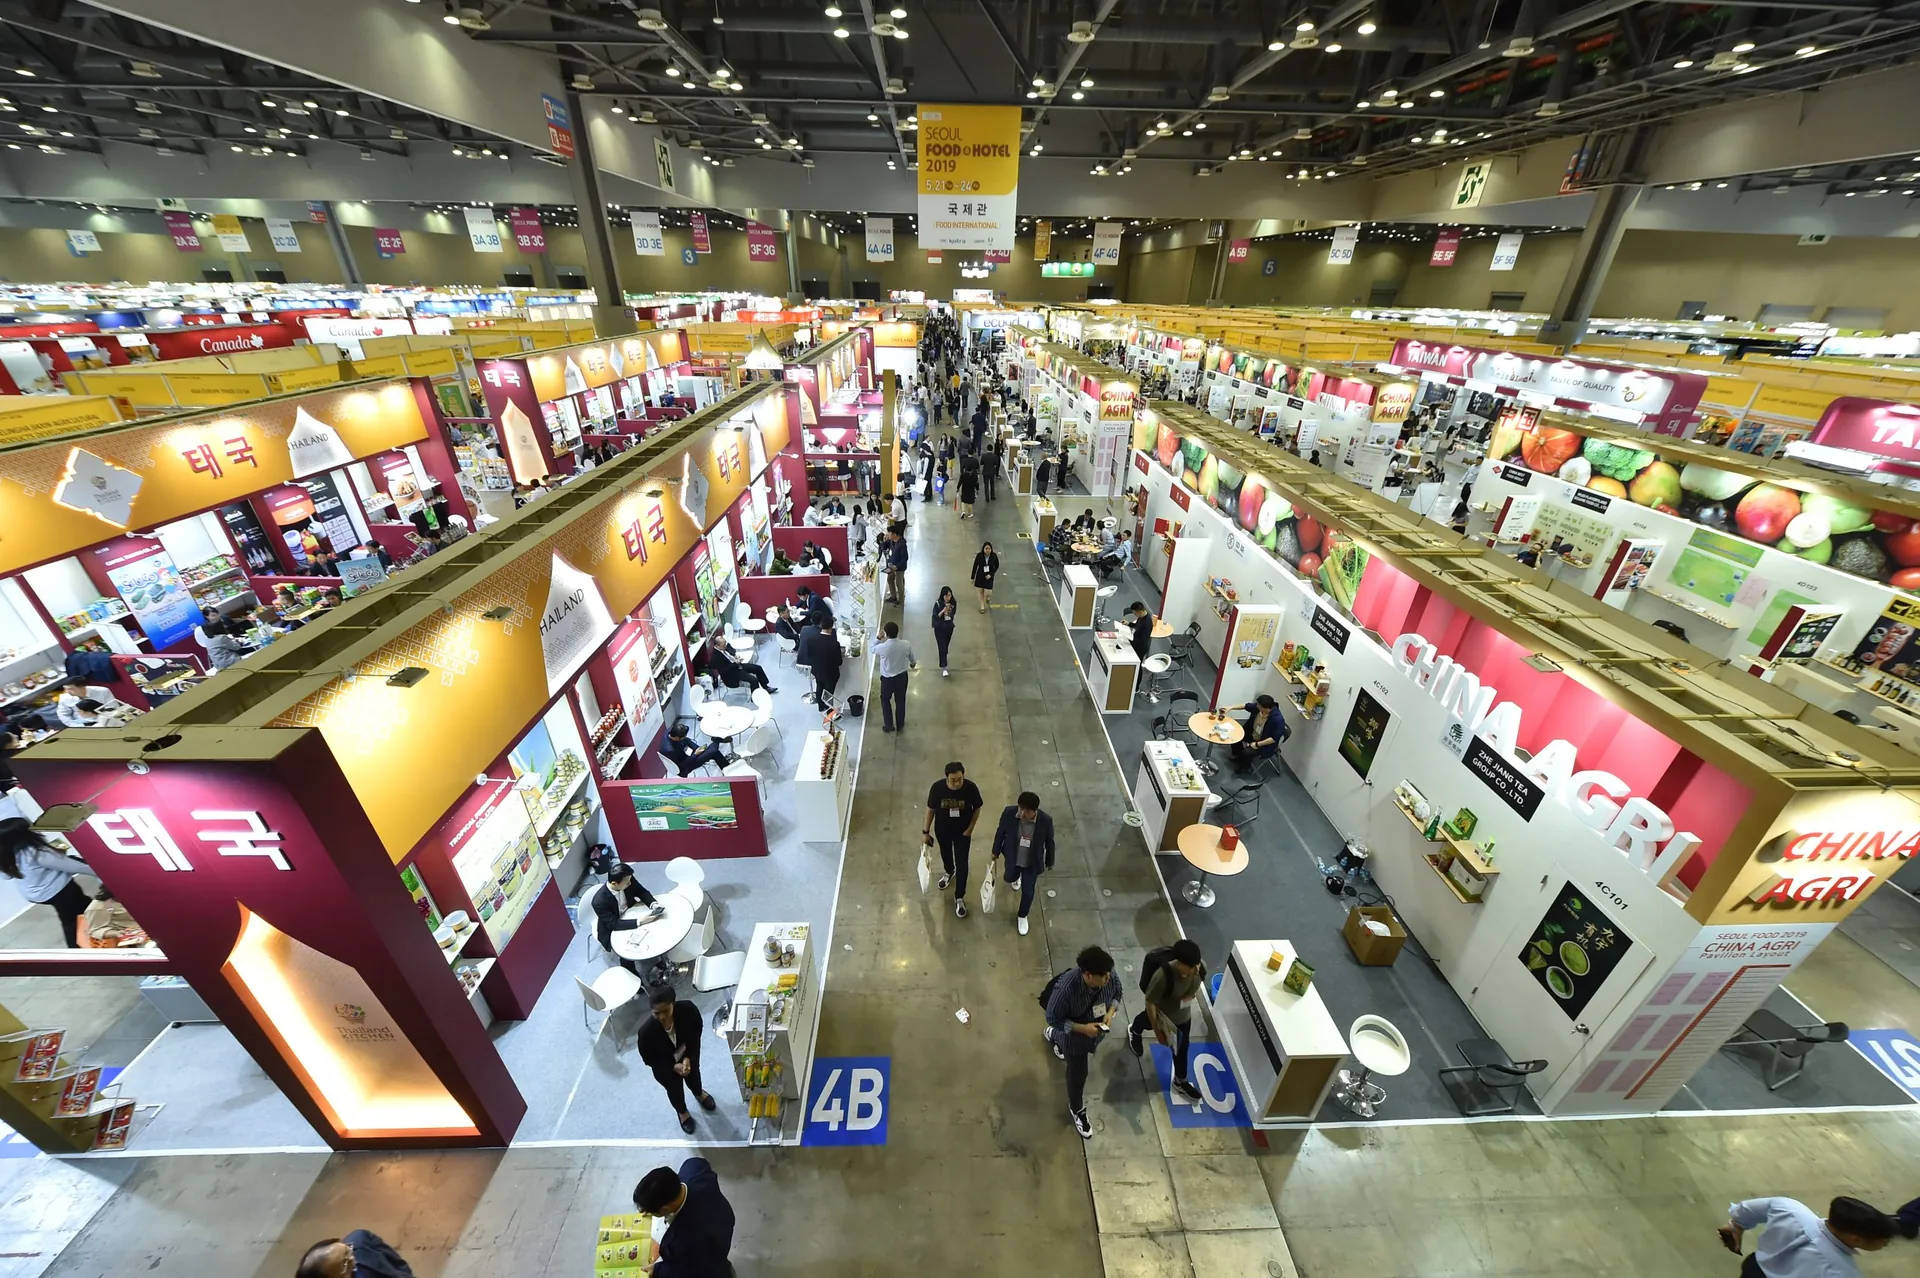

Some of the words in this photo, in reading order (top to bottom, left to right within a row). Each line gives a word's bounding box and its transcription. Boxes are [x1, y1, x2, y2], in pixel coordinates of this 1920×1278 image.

[925, 127, 962, 140] SEOUL
[925, 144, 962, 156] FOOD
[972, 144, 1010, 157] HOTEL
[926, 160, 956, 172] 2019
[926, 180, 945, 190] 5.21
[960, 181, 972, 190] 24
[174, 236, 188, 246] 2A
[188, 236, 200, 246] 2B
[274, 237, 285, 247] 2C
[286, 237, 297, 247] 2D
[378, 238, 390, 248] 2E
[391, 238, 402, 248] 2F
[472, 234, 486, 245] 3A
[487, 234, 500, 246] 3B
[517, 235, 531, 246] 3B
[532, 235, 544, 246] 3C
[636, 238, 649, 248] 3D
[651, 239, 662, 249] 3E
[751, 245, 761, 255] 3F
[764, 245, 776, 256] 3G
[868, 244, 880, 254] 4A
[881, 244, 892, 254] 4B
[1094, 248, 1105, 258] 4F
[1107, 248, 1118, 259] 4G
[1236, 248, 1247, 257] 5B
[1330, 249, 1340, 258] 5C
[1341, 249, 1352, 259] 5D
[685, 250, 694, 264] 3
[1432, 251, 1443, 261] 5E
[1443, 251, 1454, 261] 5F
[1494, 256, 1504, 265] 5F
[1505, 256, 1515, 265] 5G
[1265, 262, 1274, 274] 5
[329, 325, 371, 338] Canada
[200, 335, 250, 354] Canada
[1408, 348, 1448, 368] TAIWAN
[1550, 376, 1571, 386] TASTE
[1583, 381, 1616, 393] QUALITY
[1103, 391, 1135, 403] CHINA
[1382, 392, 1412, 404] CHINA
[1105, 404, 1130, 417] AGRI
[1382, 406, 1404, 418] AGRI
[1872, 419, 1920, 450] TA
[288, 432, 329, 451] HAILAND
[182, 435, 258, 478] 태국
[716, 442, 742, 484] 태국
[622, 503, 668, 566] 태국
[539, 588, 585, 636] HAILAND
[1373, 680, 1389, 696] 4C102
[1391, 632, 1522, 761] CHINA
[1472, 757, 1496, 782] GROUP
[1478, 749, 1494, 766] ZHE
[1492, 760, 1515, 783] JIANG
[1514, 778, 1529, 797] TEA
[1522, 739, 1703, 897] AGRI
[449, 818, 477, 848] TROPICAL
[86, 808, 296, 872] 태국
[1783, 830, 1920, 861] CHINA
[1594, 880, 1628, 910] 4C101
[1754, 875, 1876, 904] AGRI
[1716, 932, 1748, 940] SEOUL
[1750, 932, 1780, 940] FOOD
[1704, 942, 1756, 953] CHINA
[1758, 940, 1802, 951] AGRI
[1749, 951, 1791, 959] Layout
[1237, 980, 1268, 1043] INFORMATION
[334, 1026, 390, 1034] Thailand
[810, 1067, 886, 1132] 4B
